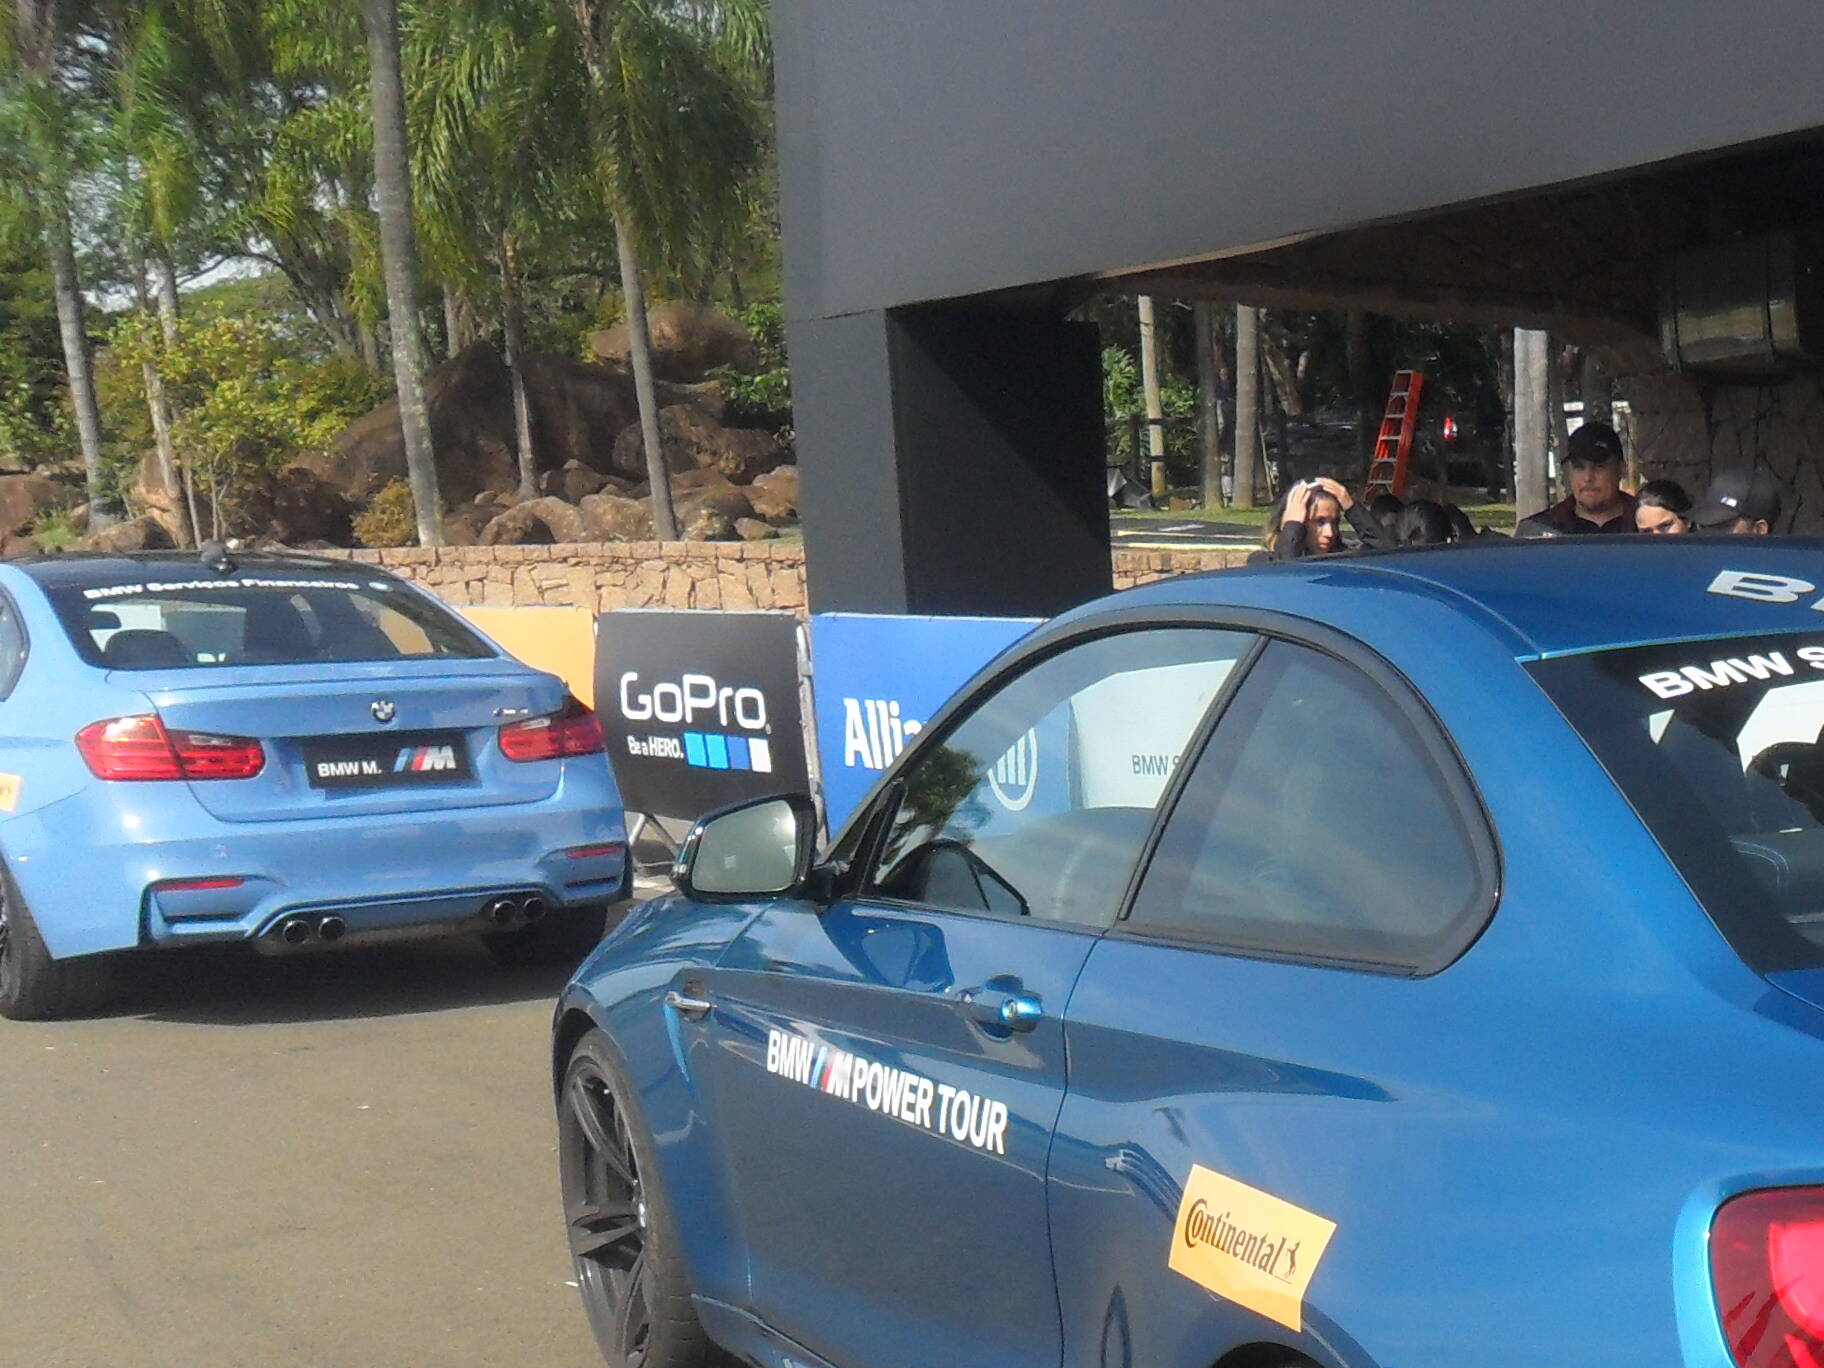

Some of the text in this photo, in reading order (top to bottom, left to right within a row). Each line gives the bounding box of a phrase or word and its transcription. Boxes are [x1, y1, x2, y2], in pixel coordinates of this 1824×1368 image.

[620, 672, 767, 730] GoPro
[1638, 652, 1794, 699] BMW
[627, 735, 685, 759] Be a HERO.
[843, 697, 926, 770] Alli
[317, 762, 360, 777] BMW
[1131, 754, 1169, 776] BMW
[767, 1030, 815, 1085] BMW
[851, 1057, 934, 1128] POWER
[937, 1083, 1009, 1155] TOUR
[1185, 1198, 1288, 1276] Continental
